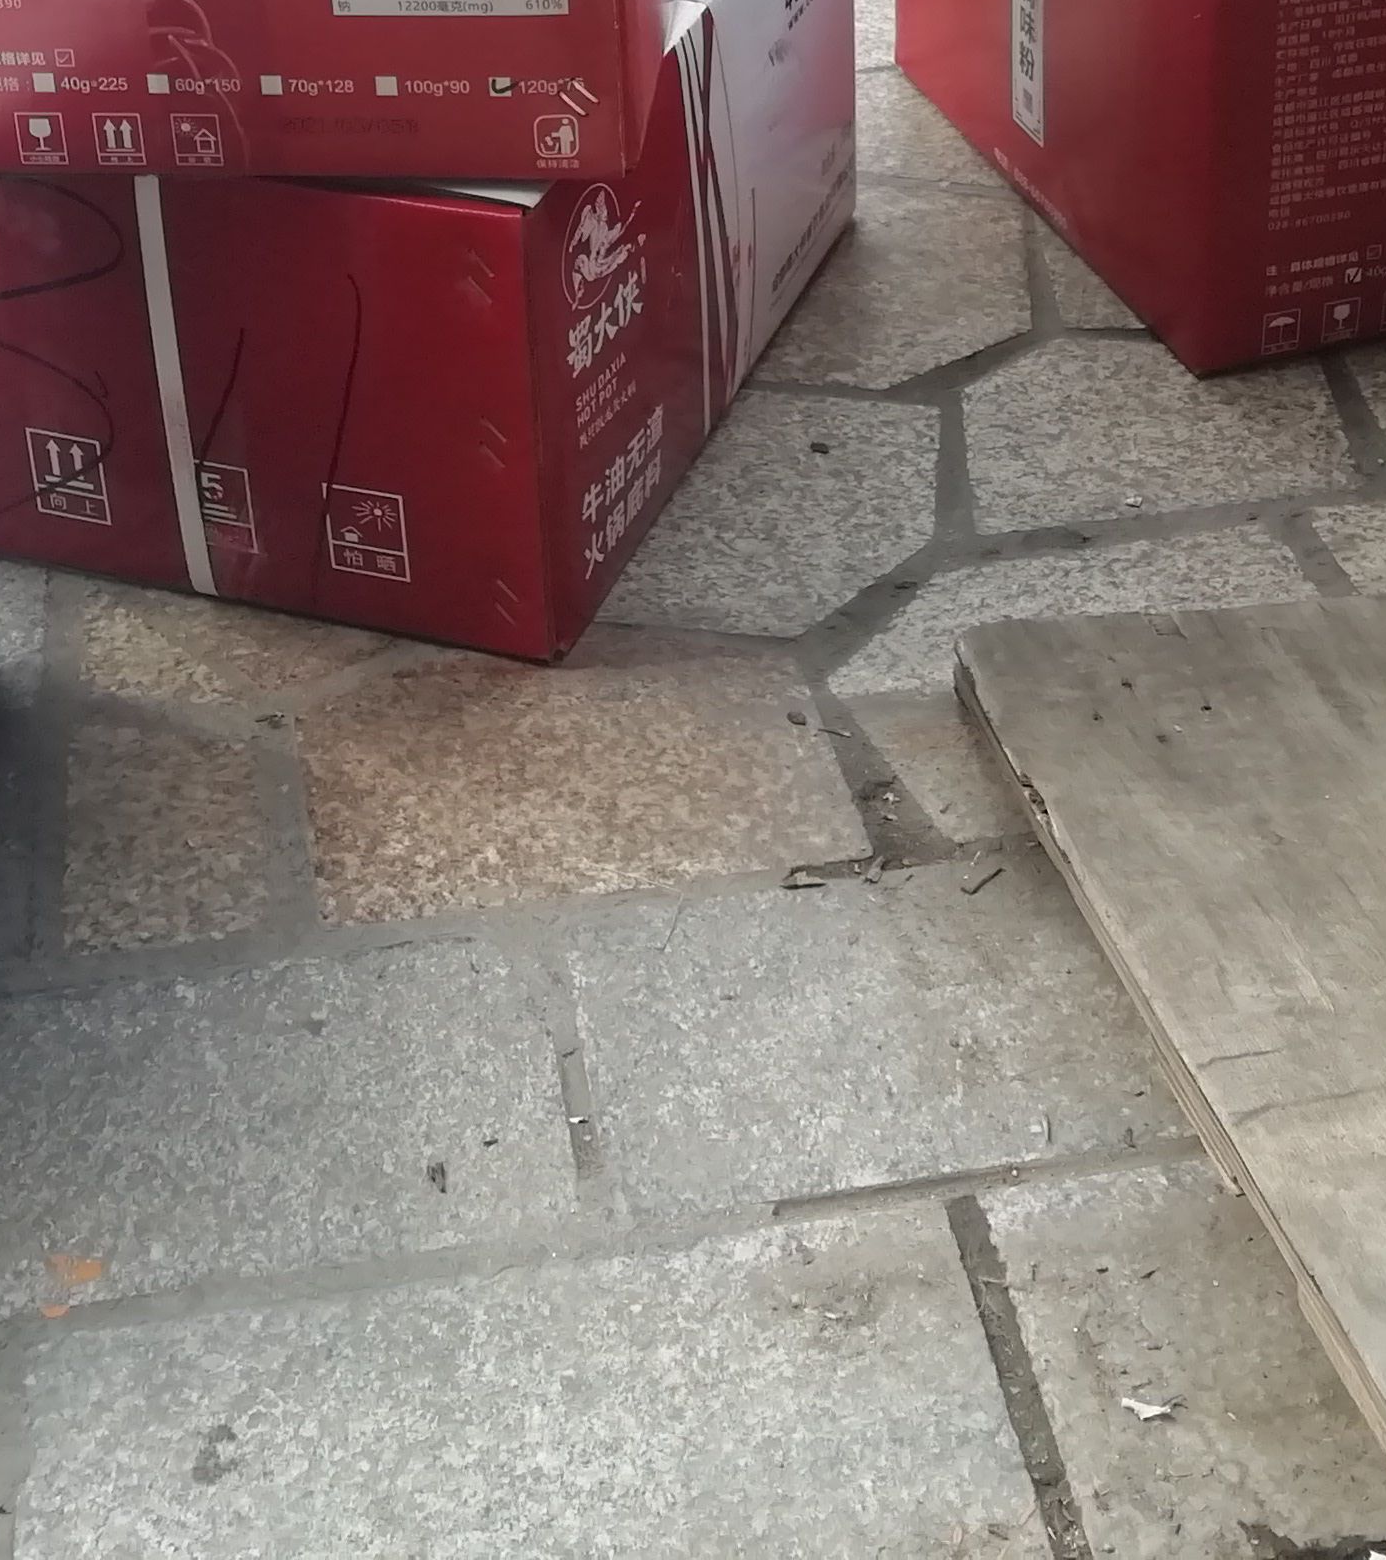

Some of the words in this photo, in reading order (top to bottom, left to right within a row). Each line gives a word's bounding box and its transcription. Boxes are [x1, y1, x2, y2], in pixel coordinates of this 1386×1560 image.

[337, 0, 351, 13] 钠
[566, 271, 645, 379] 蜀大侠
[576, 381, 597, 412] SHU
[598, 351, 627, 390] DAXIA
[577, 398, 597, 429] HOT
[599, 376, 618, 406] POT
[584, 448, 663, 581] 火锅底料
